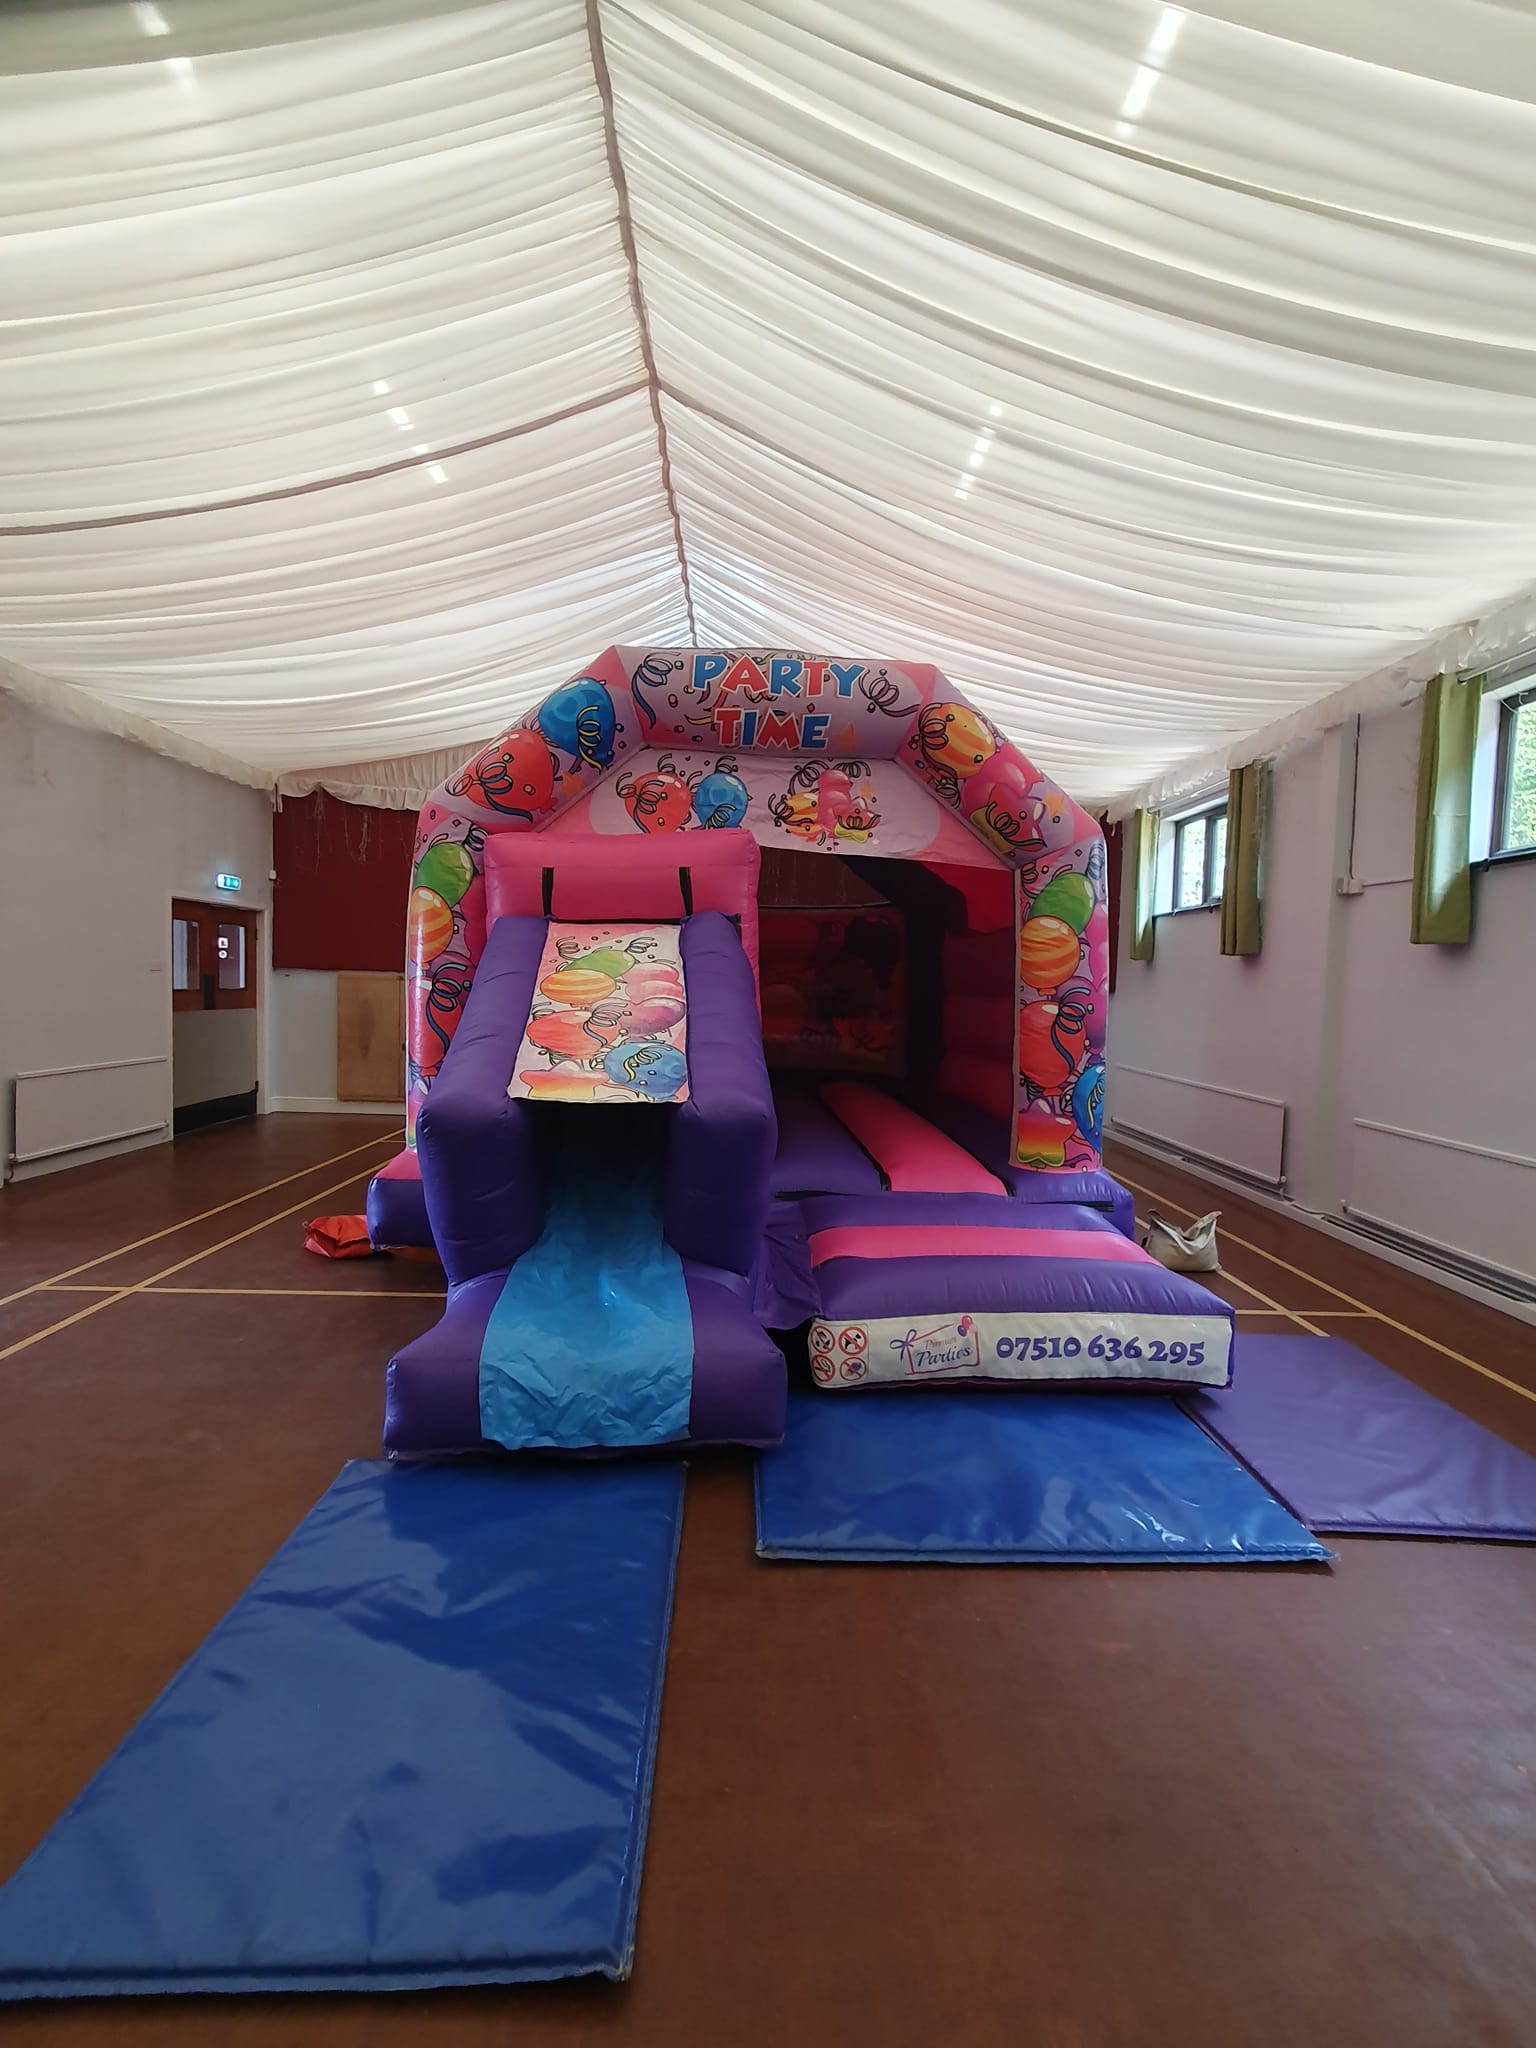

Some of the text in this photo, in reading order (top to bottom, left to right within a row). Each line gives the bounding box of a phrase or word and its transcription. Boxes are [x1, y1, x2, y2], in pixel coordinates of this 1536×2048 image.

[691, 654, 865, 698] PARTY
[714, 708, 832, 749] TIME
[917, 1346, 971, 1367] Parties
[996, 1334, 1205, 1366] 07510 636 295
